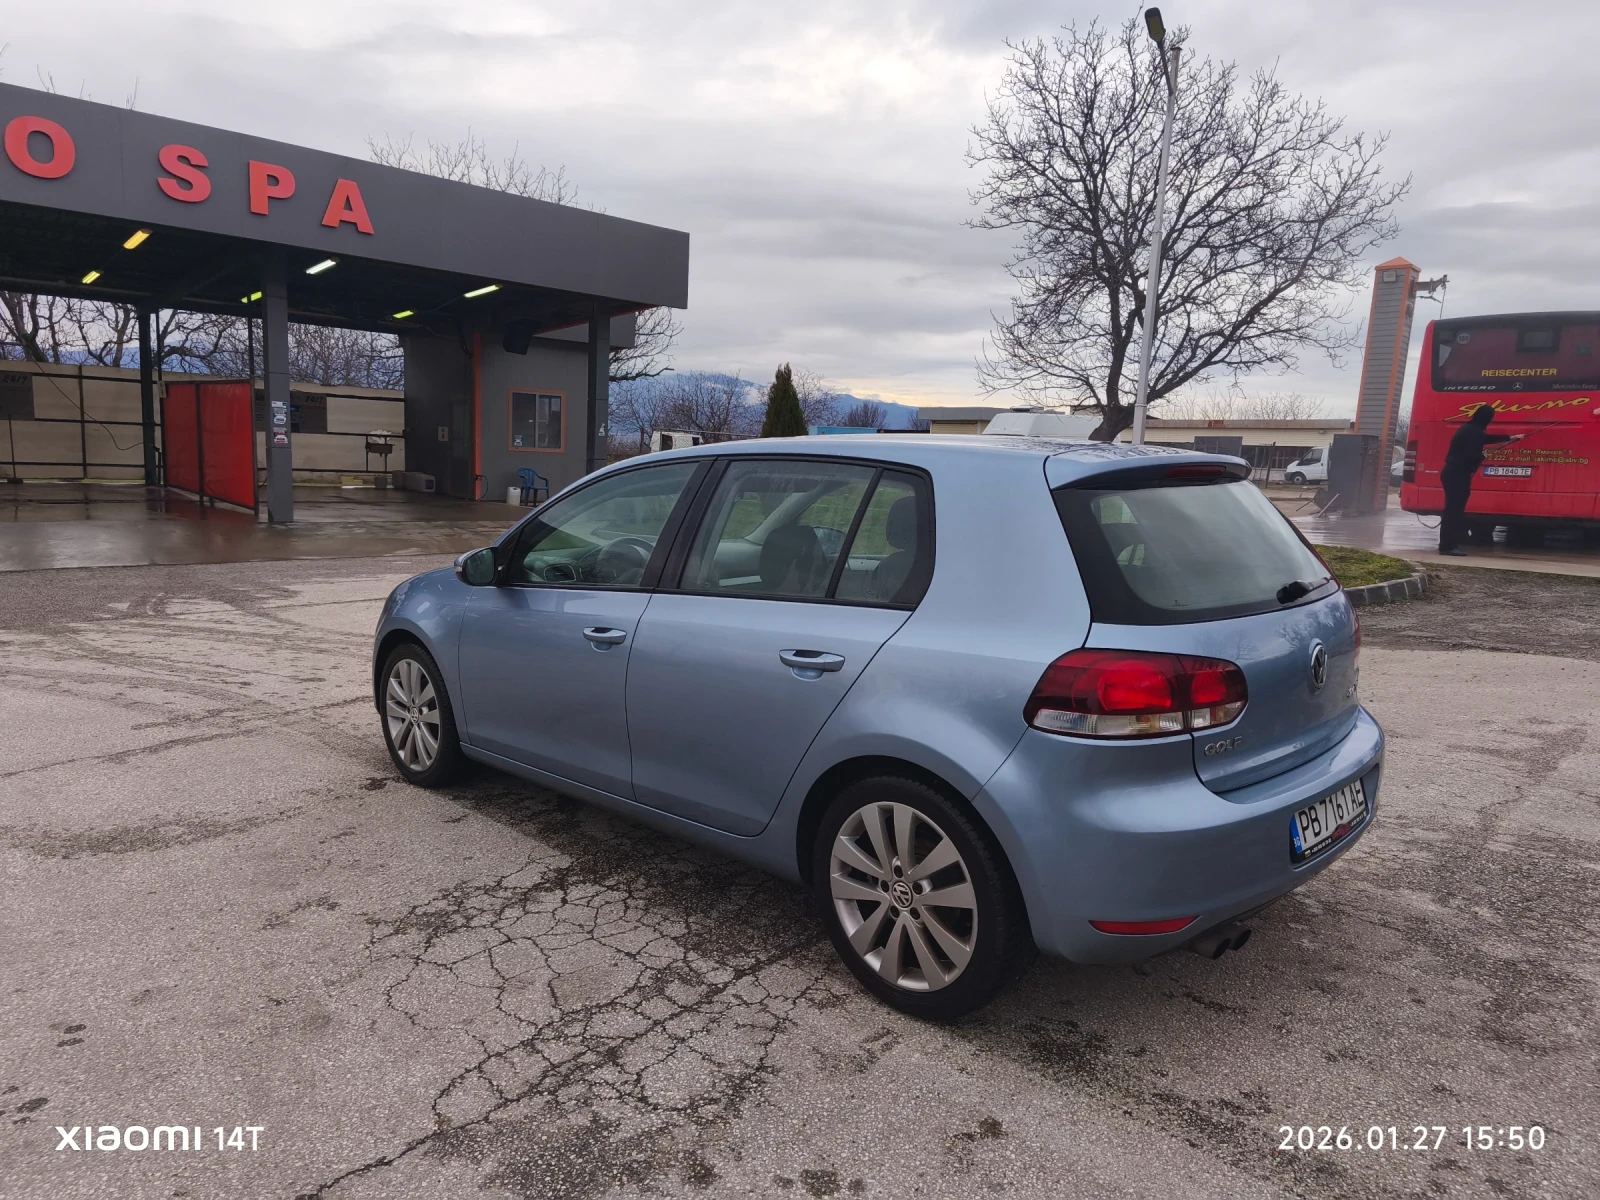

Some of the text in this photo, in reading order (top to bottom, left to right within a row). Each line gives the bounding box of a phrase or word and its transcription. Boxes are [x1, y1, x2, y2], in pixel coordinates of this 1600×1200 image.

[157, 144, 375, 235] SPA
[1481, 368, 1557, 377] REISECENTER
[1520, 468, 1530, 476] TE
[1204, 735, 1242, 756] GOLF
[1298, 783, 1364, 844] PB 7161 AE
